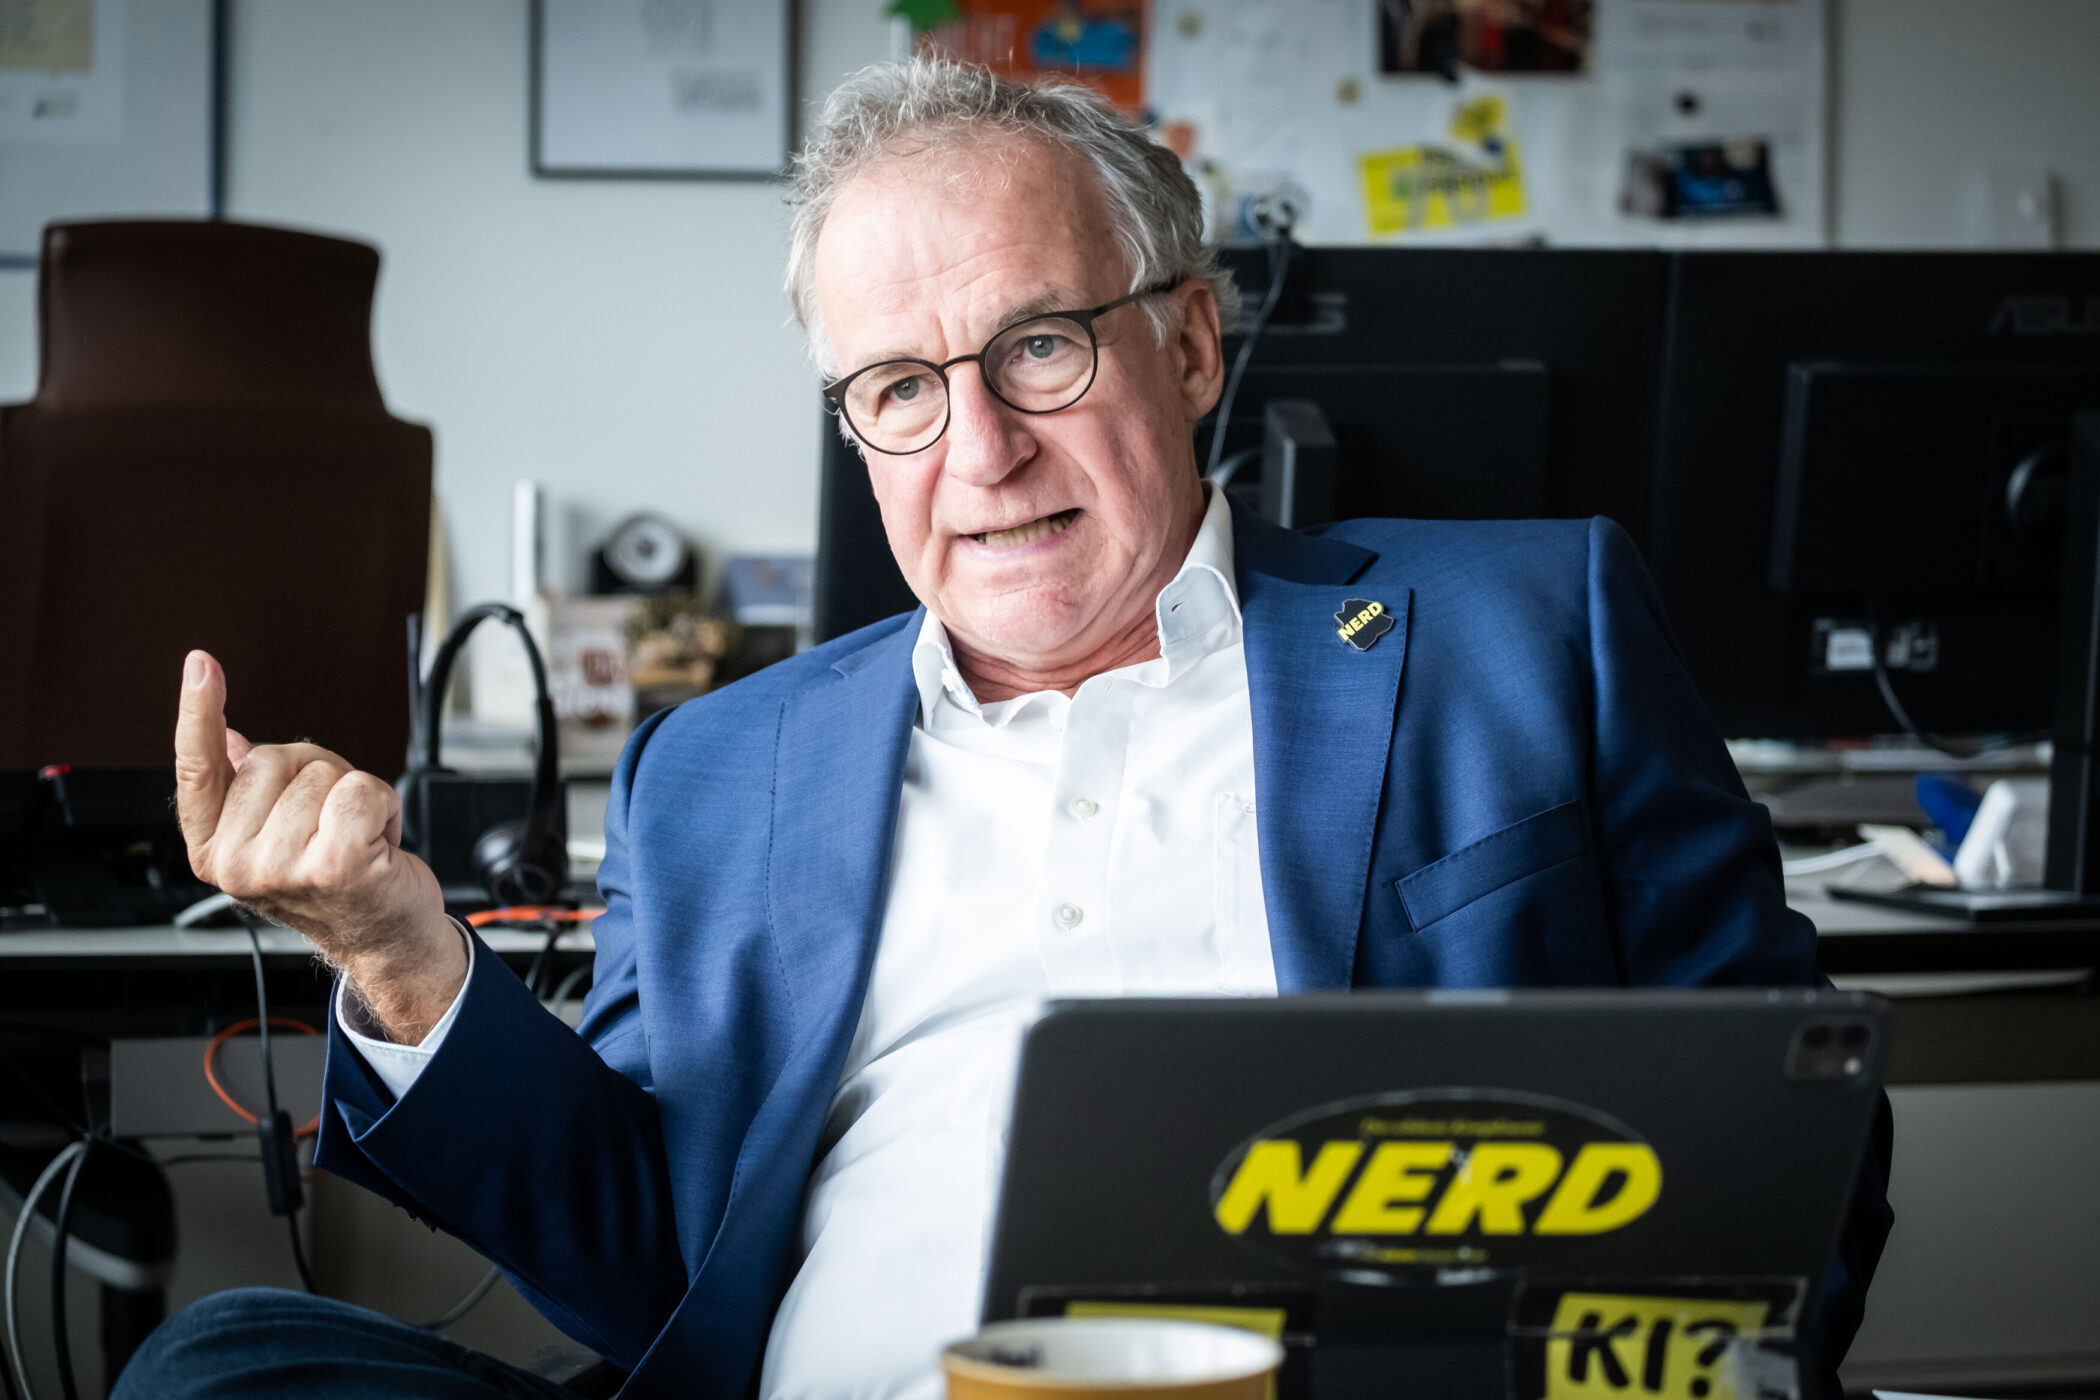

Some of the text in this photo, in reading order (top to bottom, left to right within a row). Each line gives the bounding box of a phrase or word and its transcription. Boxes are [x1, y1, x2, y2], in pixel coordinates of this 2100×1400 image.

[1337, 601, 1384, 641] NERD
[1215, 1140, 1663, 1235] NERD
[1568, 1312, 1737, 1398] KI?
